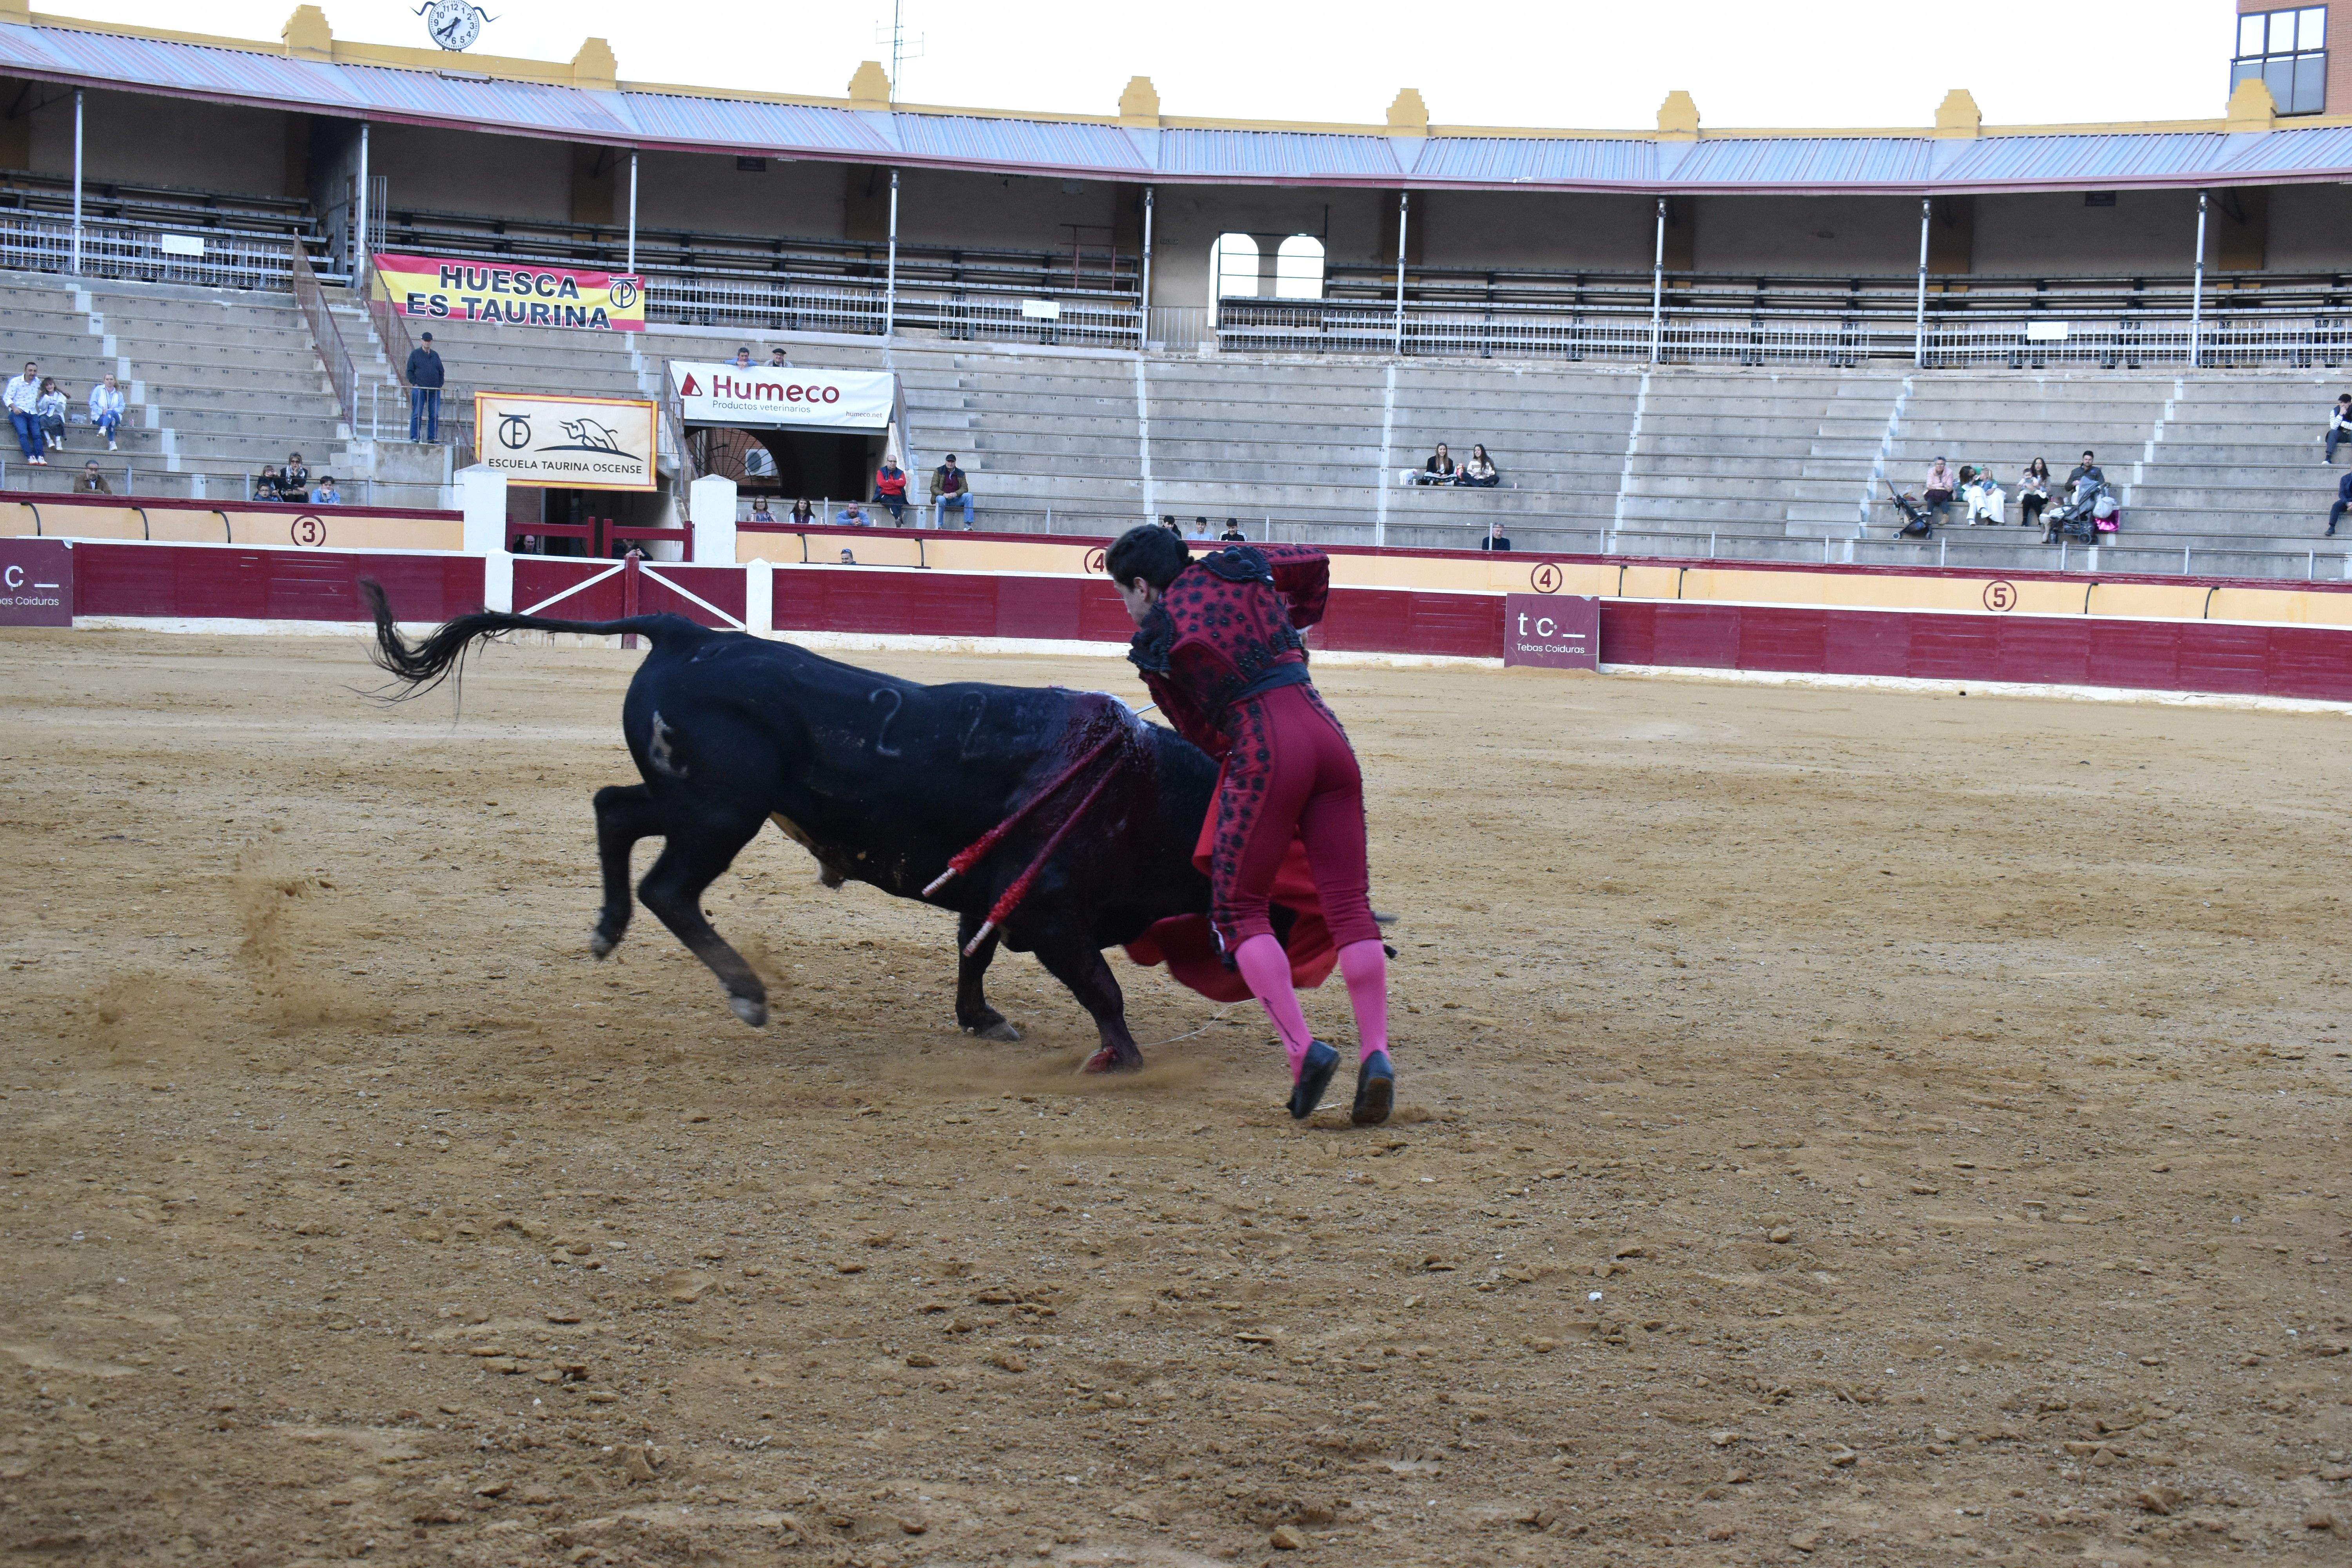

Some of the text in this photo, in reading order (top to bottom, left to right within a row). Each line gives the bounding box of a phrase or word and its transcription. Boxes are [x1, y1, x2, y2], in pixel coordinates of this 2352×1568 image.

[440, 265, 580, 299] HUESCA
[406, 292, 450, 318] ES
[461, 296, 612, 330] TAURINA
[713, 375, 840, 403] Humeco
[713, 400, 811, 413] Productos veterinarios
[489, 458, 642, 474] ESCUELA TAURINA OSCENSE
[302, 521, 316, 543] 3
[1093, 553, 1104, 572] 4
[1540, 569, 1551, 588] 4
[16, 597, 59, 605] Coiduras
[1993, 587, 2006, 608] 5
[1517, 643, 1584, 653] Tebas Coiduras
